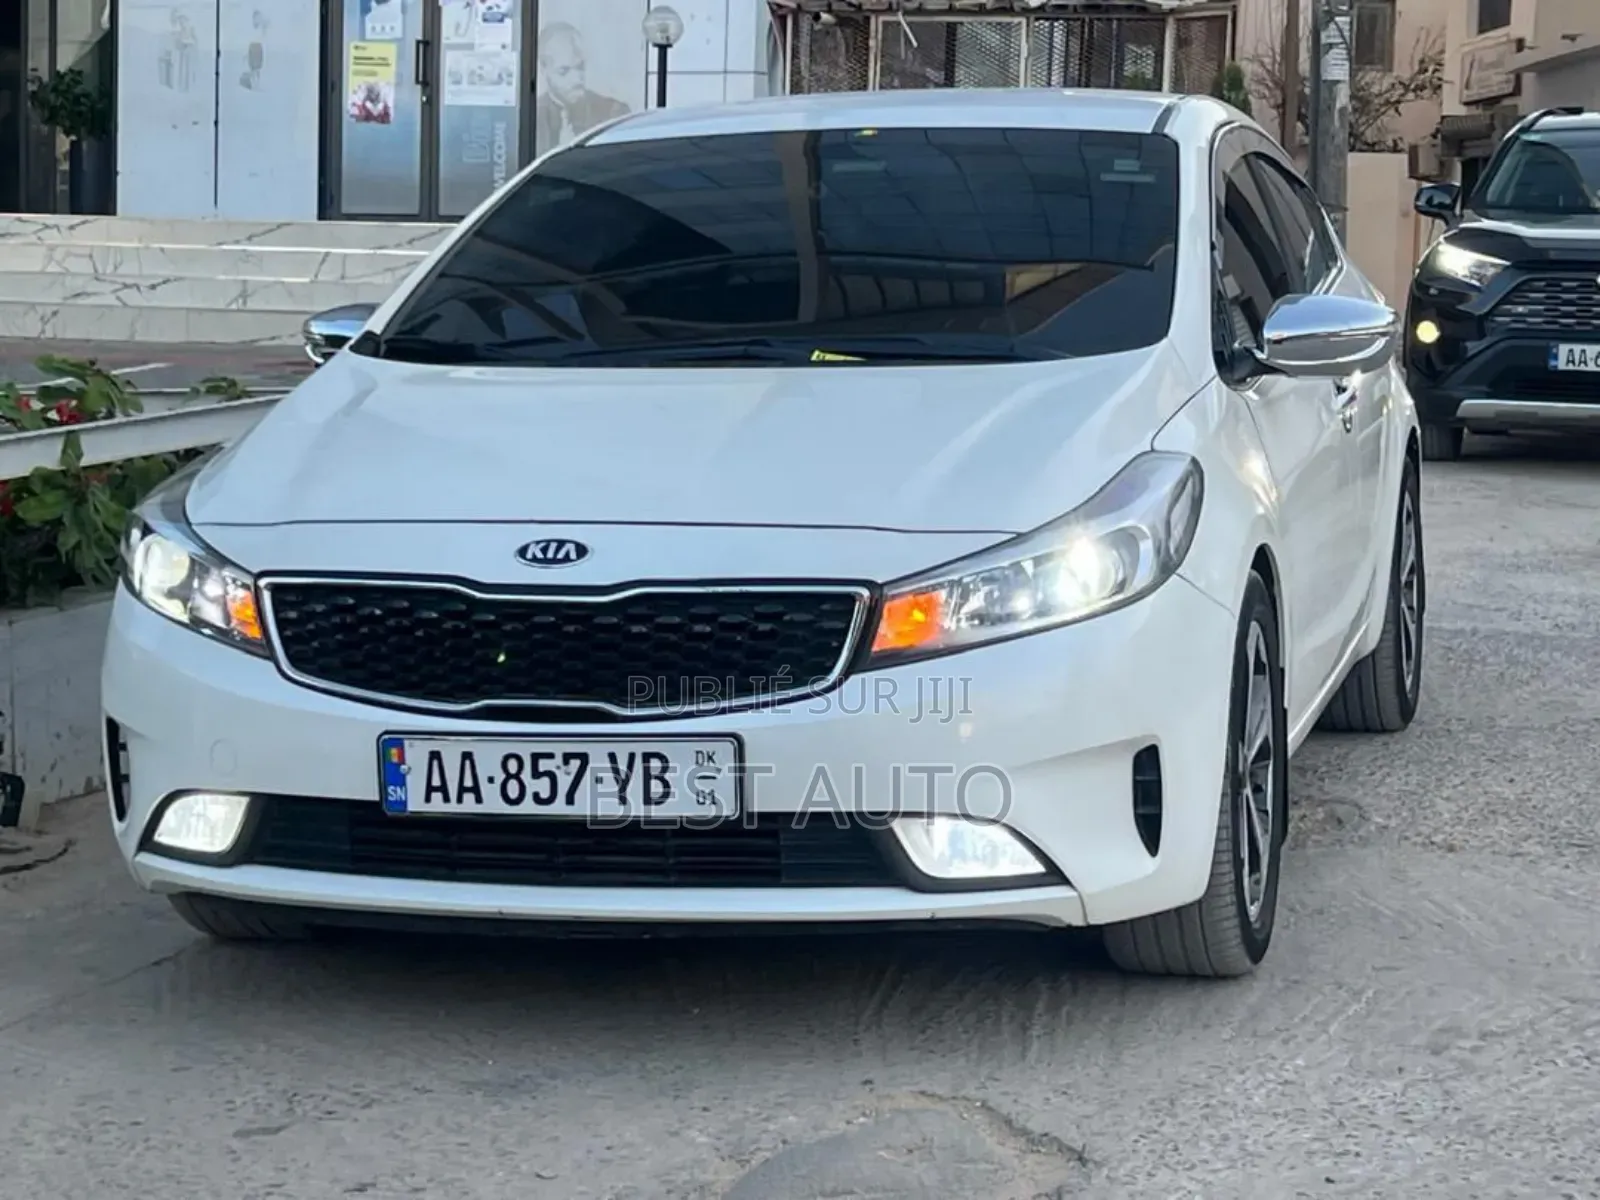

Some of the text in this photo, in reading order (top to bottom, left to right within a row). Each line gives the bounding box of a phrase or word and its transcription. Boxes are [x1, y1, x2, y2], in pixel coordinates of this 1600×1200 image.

[525, 541, 577, 560] KIA
[694, 750, 717, 765] DK
[386, 785, 407, 801] SN
